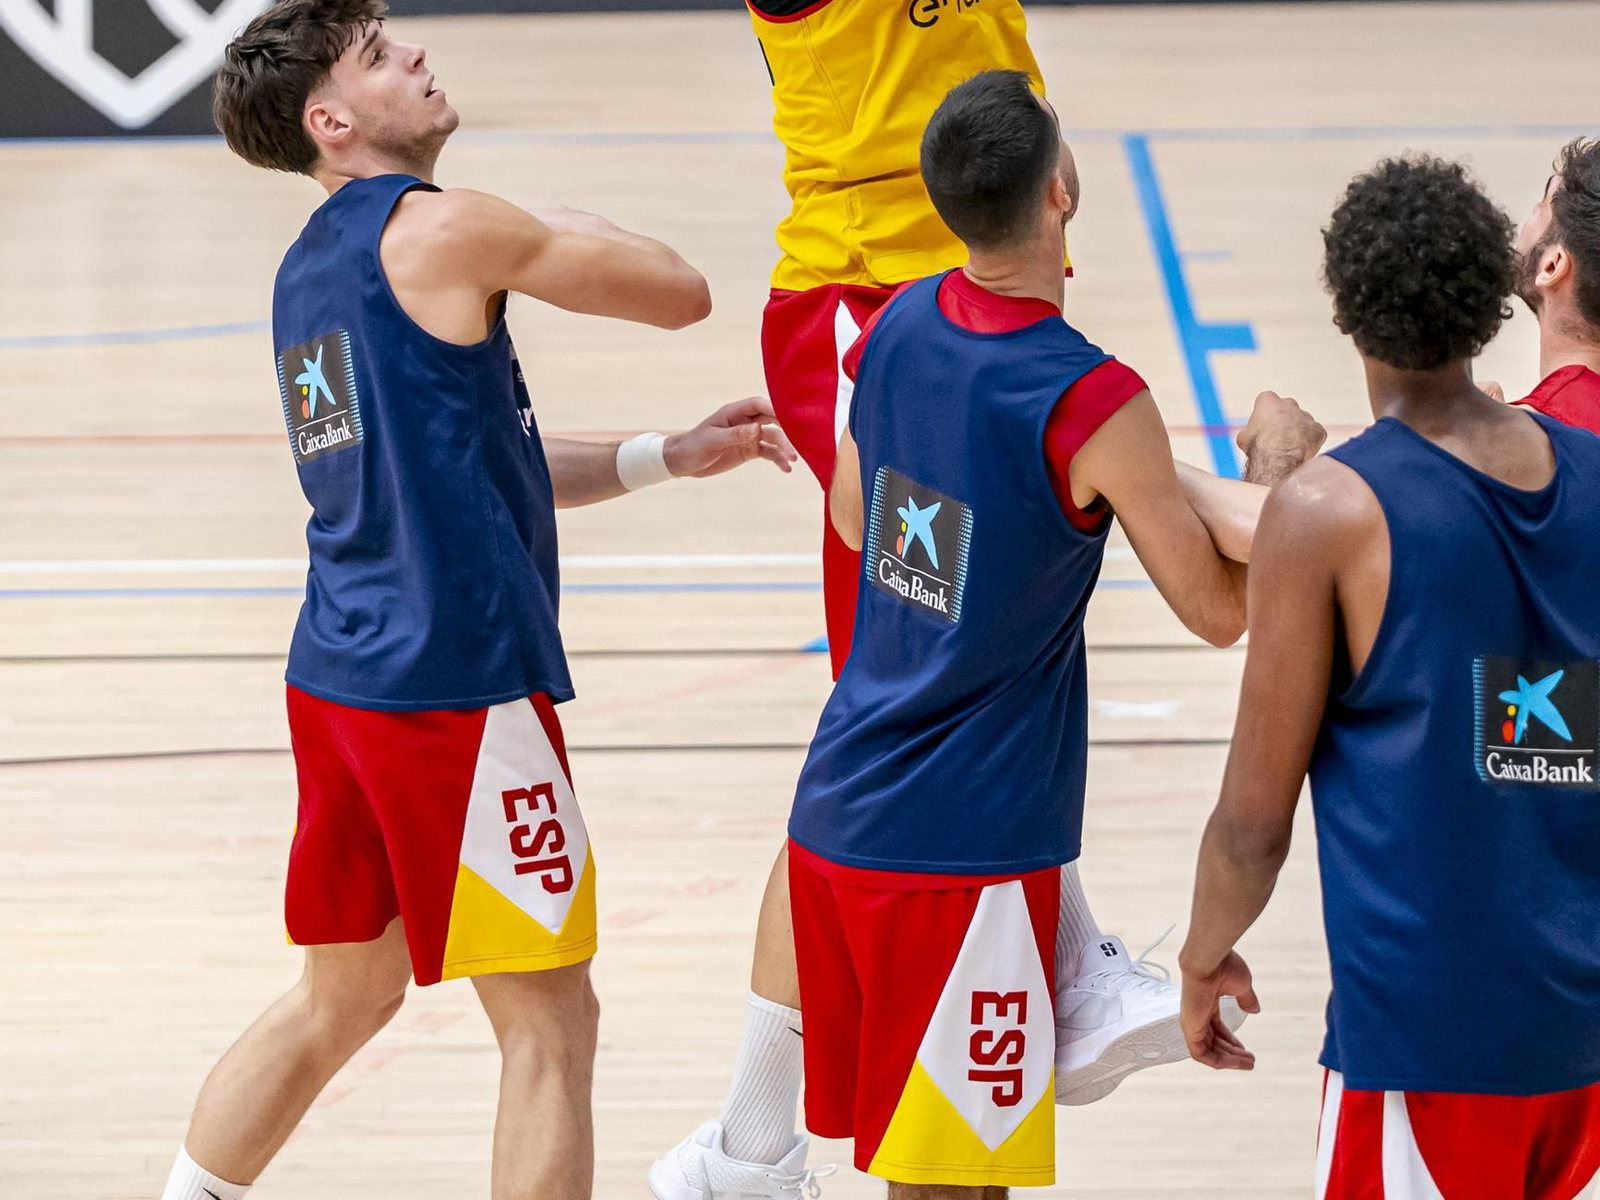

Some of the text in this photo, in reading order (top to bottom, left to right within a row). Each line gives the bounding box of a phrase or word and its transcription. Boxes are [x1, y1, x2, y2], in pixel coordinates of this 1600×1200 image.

[297, 420, 354, 456] CaixaBank
[878, 557, 950, 614] CaixaBank
[1486, 751, 1595, 783] CaixaBank
[501, 781, 575, 895] ESP
[967, 990, 1028, 1108] ESP
